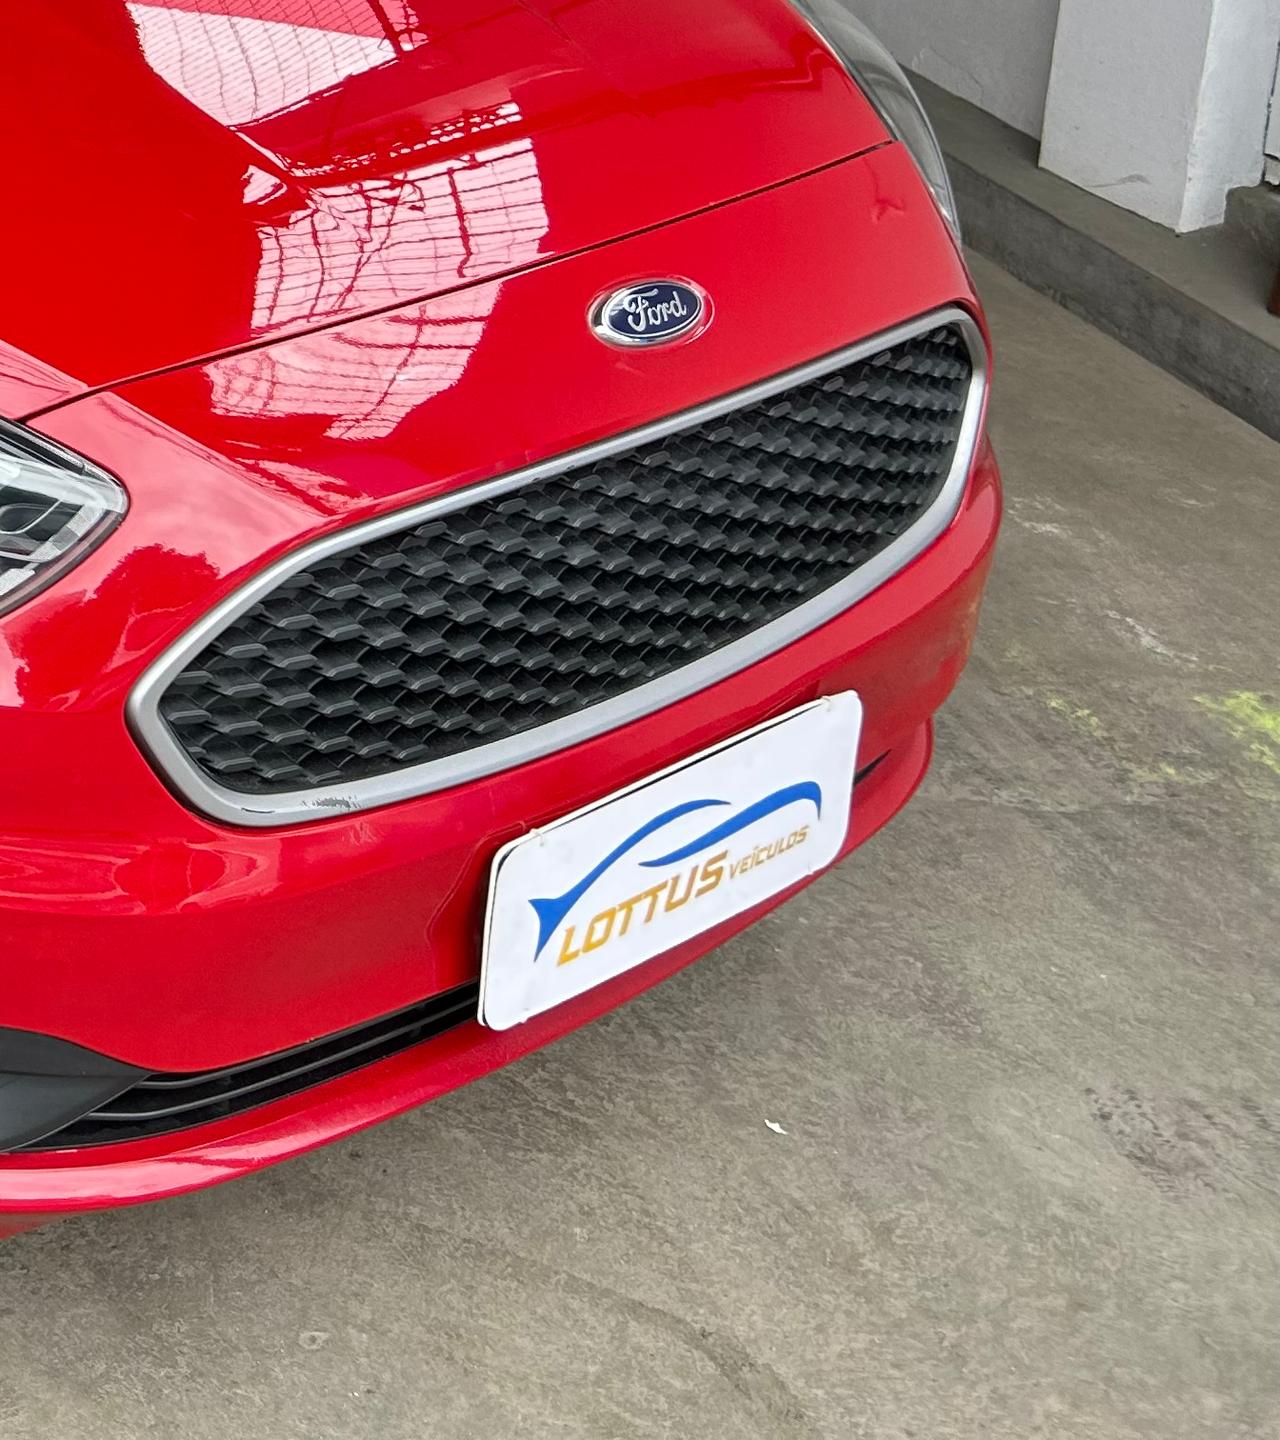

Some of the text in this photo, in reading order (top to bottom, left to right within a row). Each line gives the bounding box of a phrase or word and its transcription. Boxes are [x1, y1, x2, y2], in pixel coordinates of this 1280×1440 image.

[623, 288, 687, 332] Ford
[557, 825, 809, 966] LOTTUS VEÍCULOS
